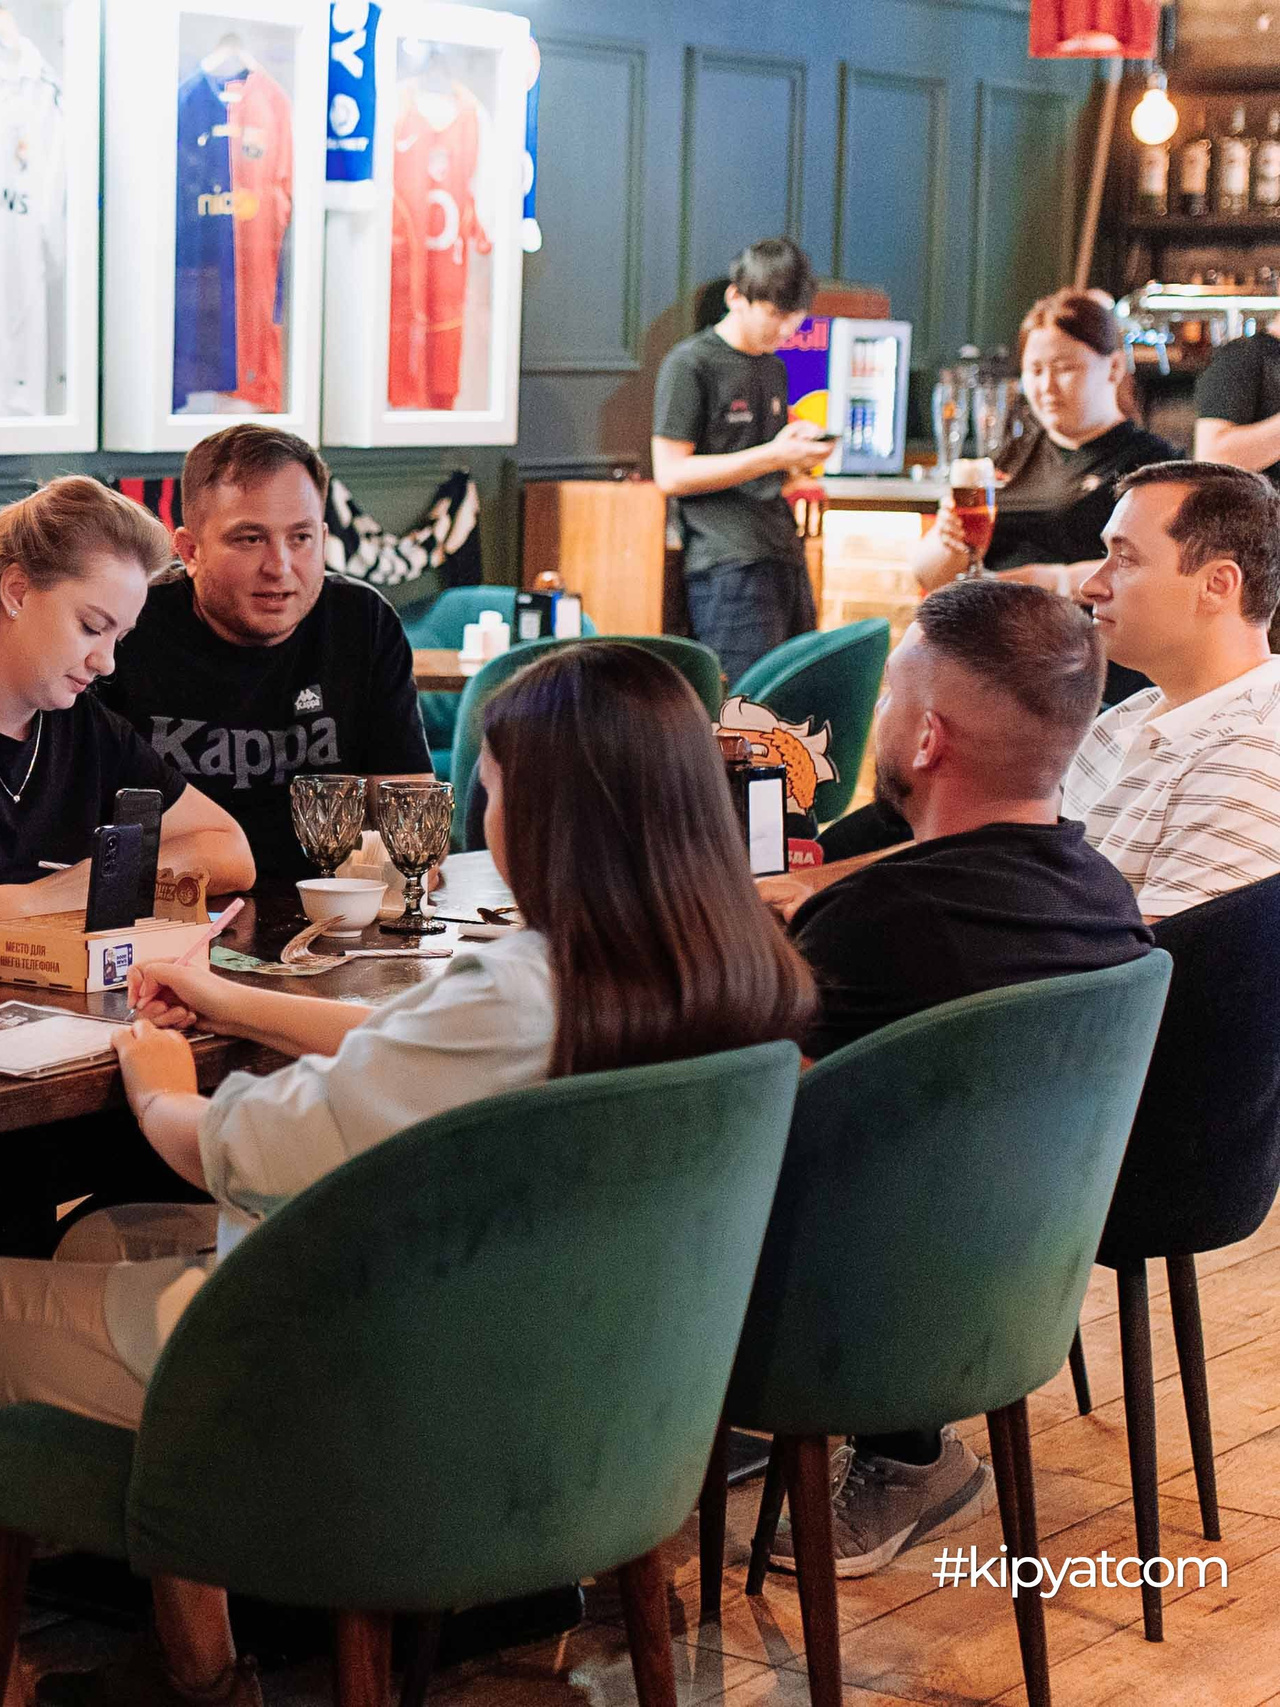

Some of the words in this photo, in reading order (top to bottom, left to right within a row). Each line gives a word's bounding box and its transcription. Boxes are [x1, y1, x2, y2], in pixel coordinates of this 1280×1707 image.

[294, 699, 320, 711] Kappa
[150, 716, 341, 789] Kappa
[5, 941, 29, 955] МЕСТО
[30, 944, 46, 956] ДЛЯ
[21, 958, 60, 973] ТЕЛЕФОНА
